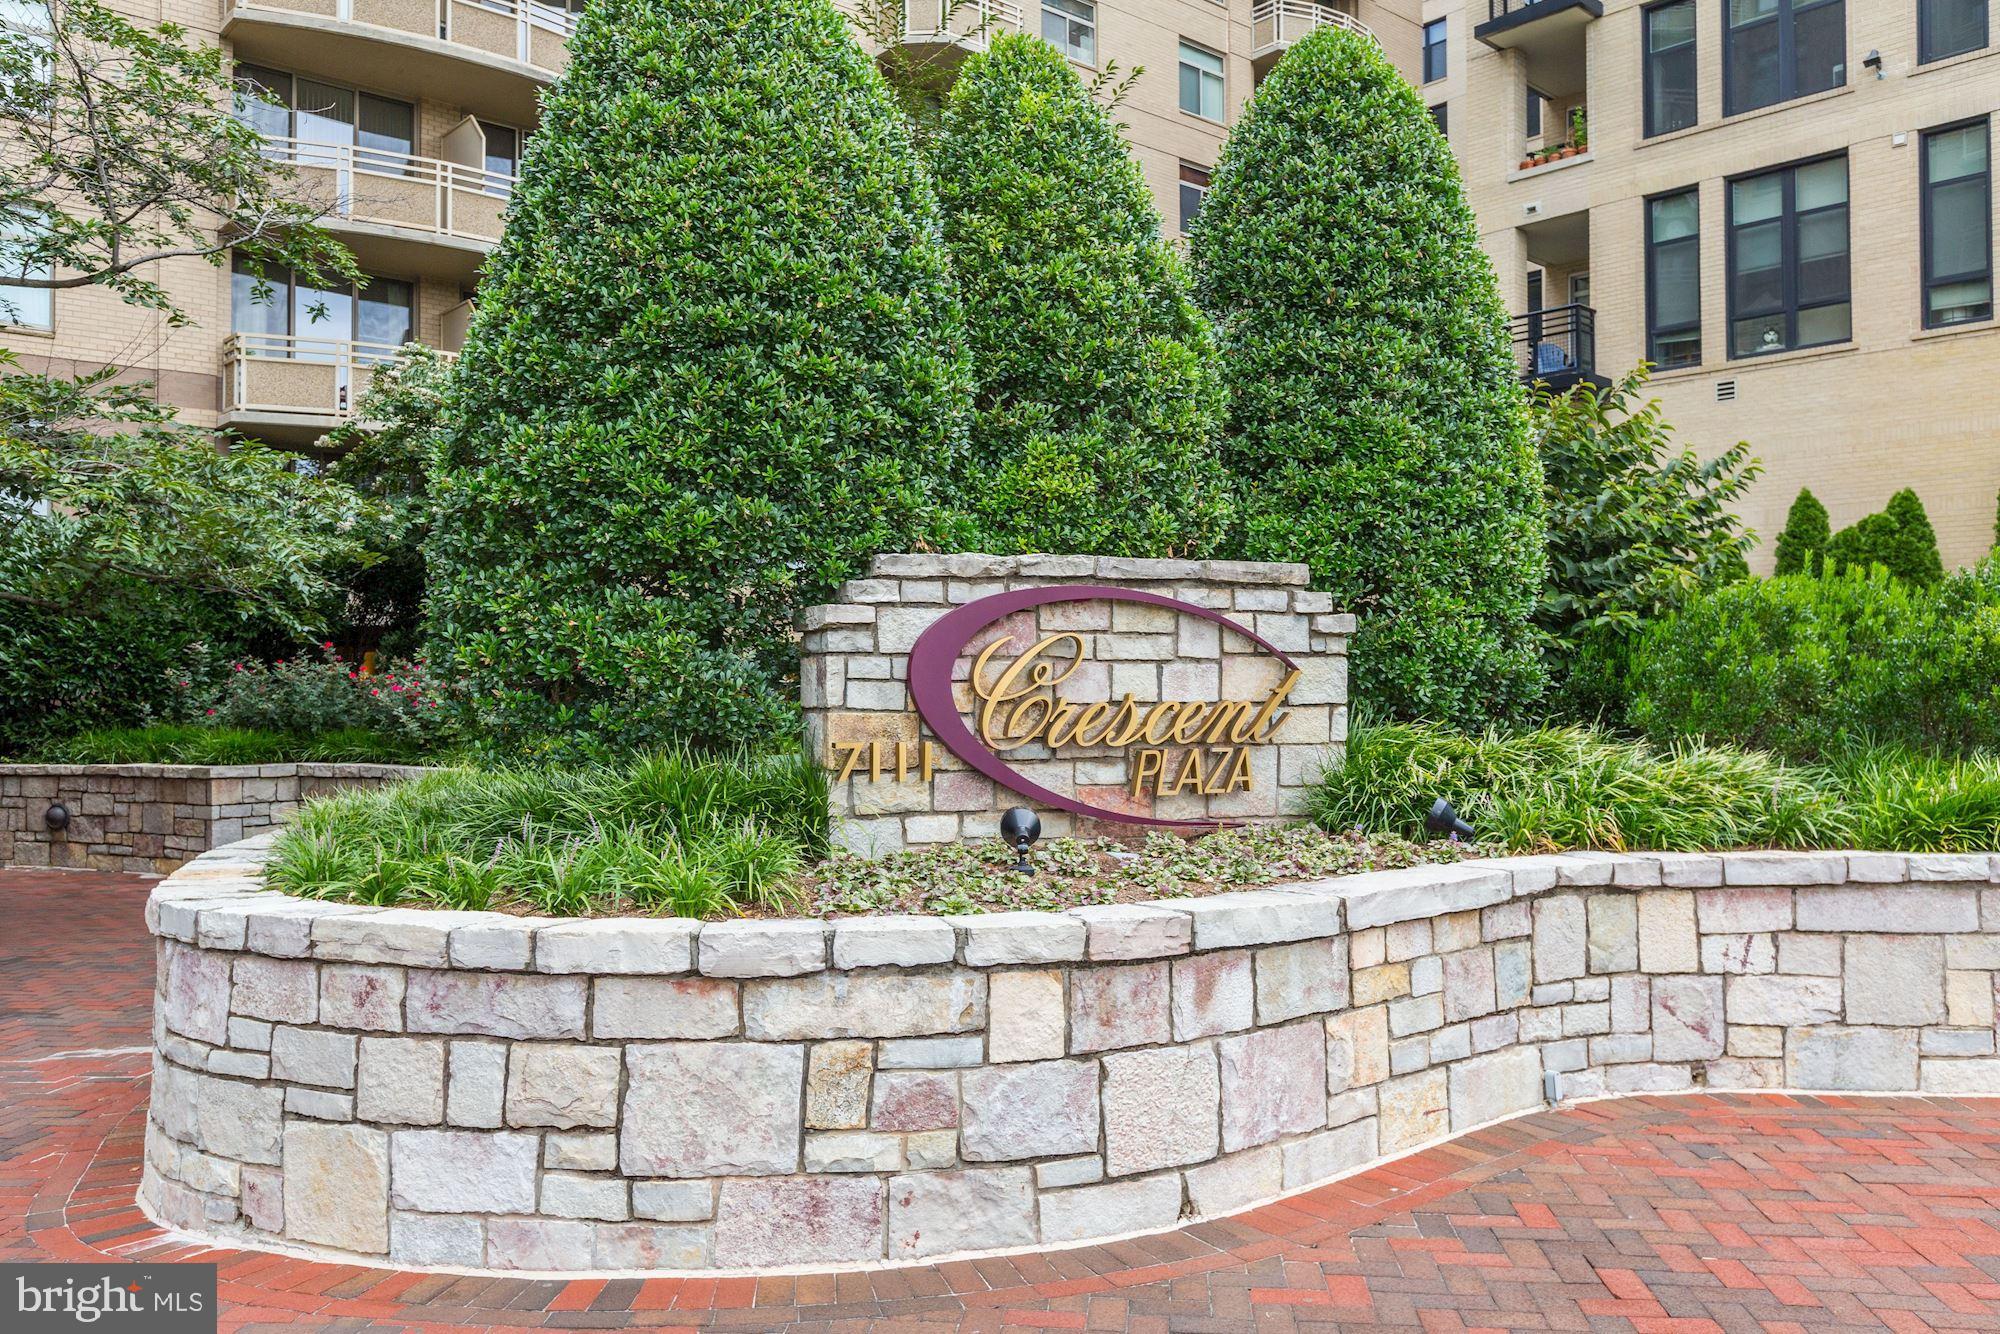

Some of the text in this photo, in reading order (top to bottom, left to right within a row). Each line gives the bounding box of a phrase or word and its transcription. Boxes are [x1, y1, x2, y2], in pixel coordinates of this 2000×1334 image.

[971, 632, 1302, 751] Crescent
[831, 741, 933, 783] 7111
[1131, 746, 1256, 798] PLAZA
